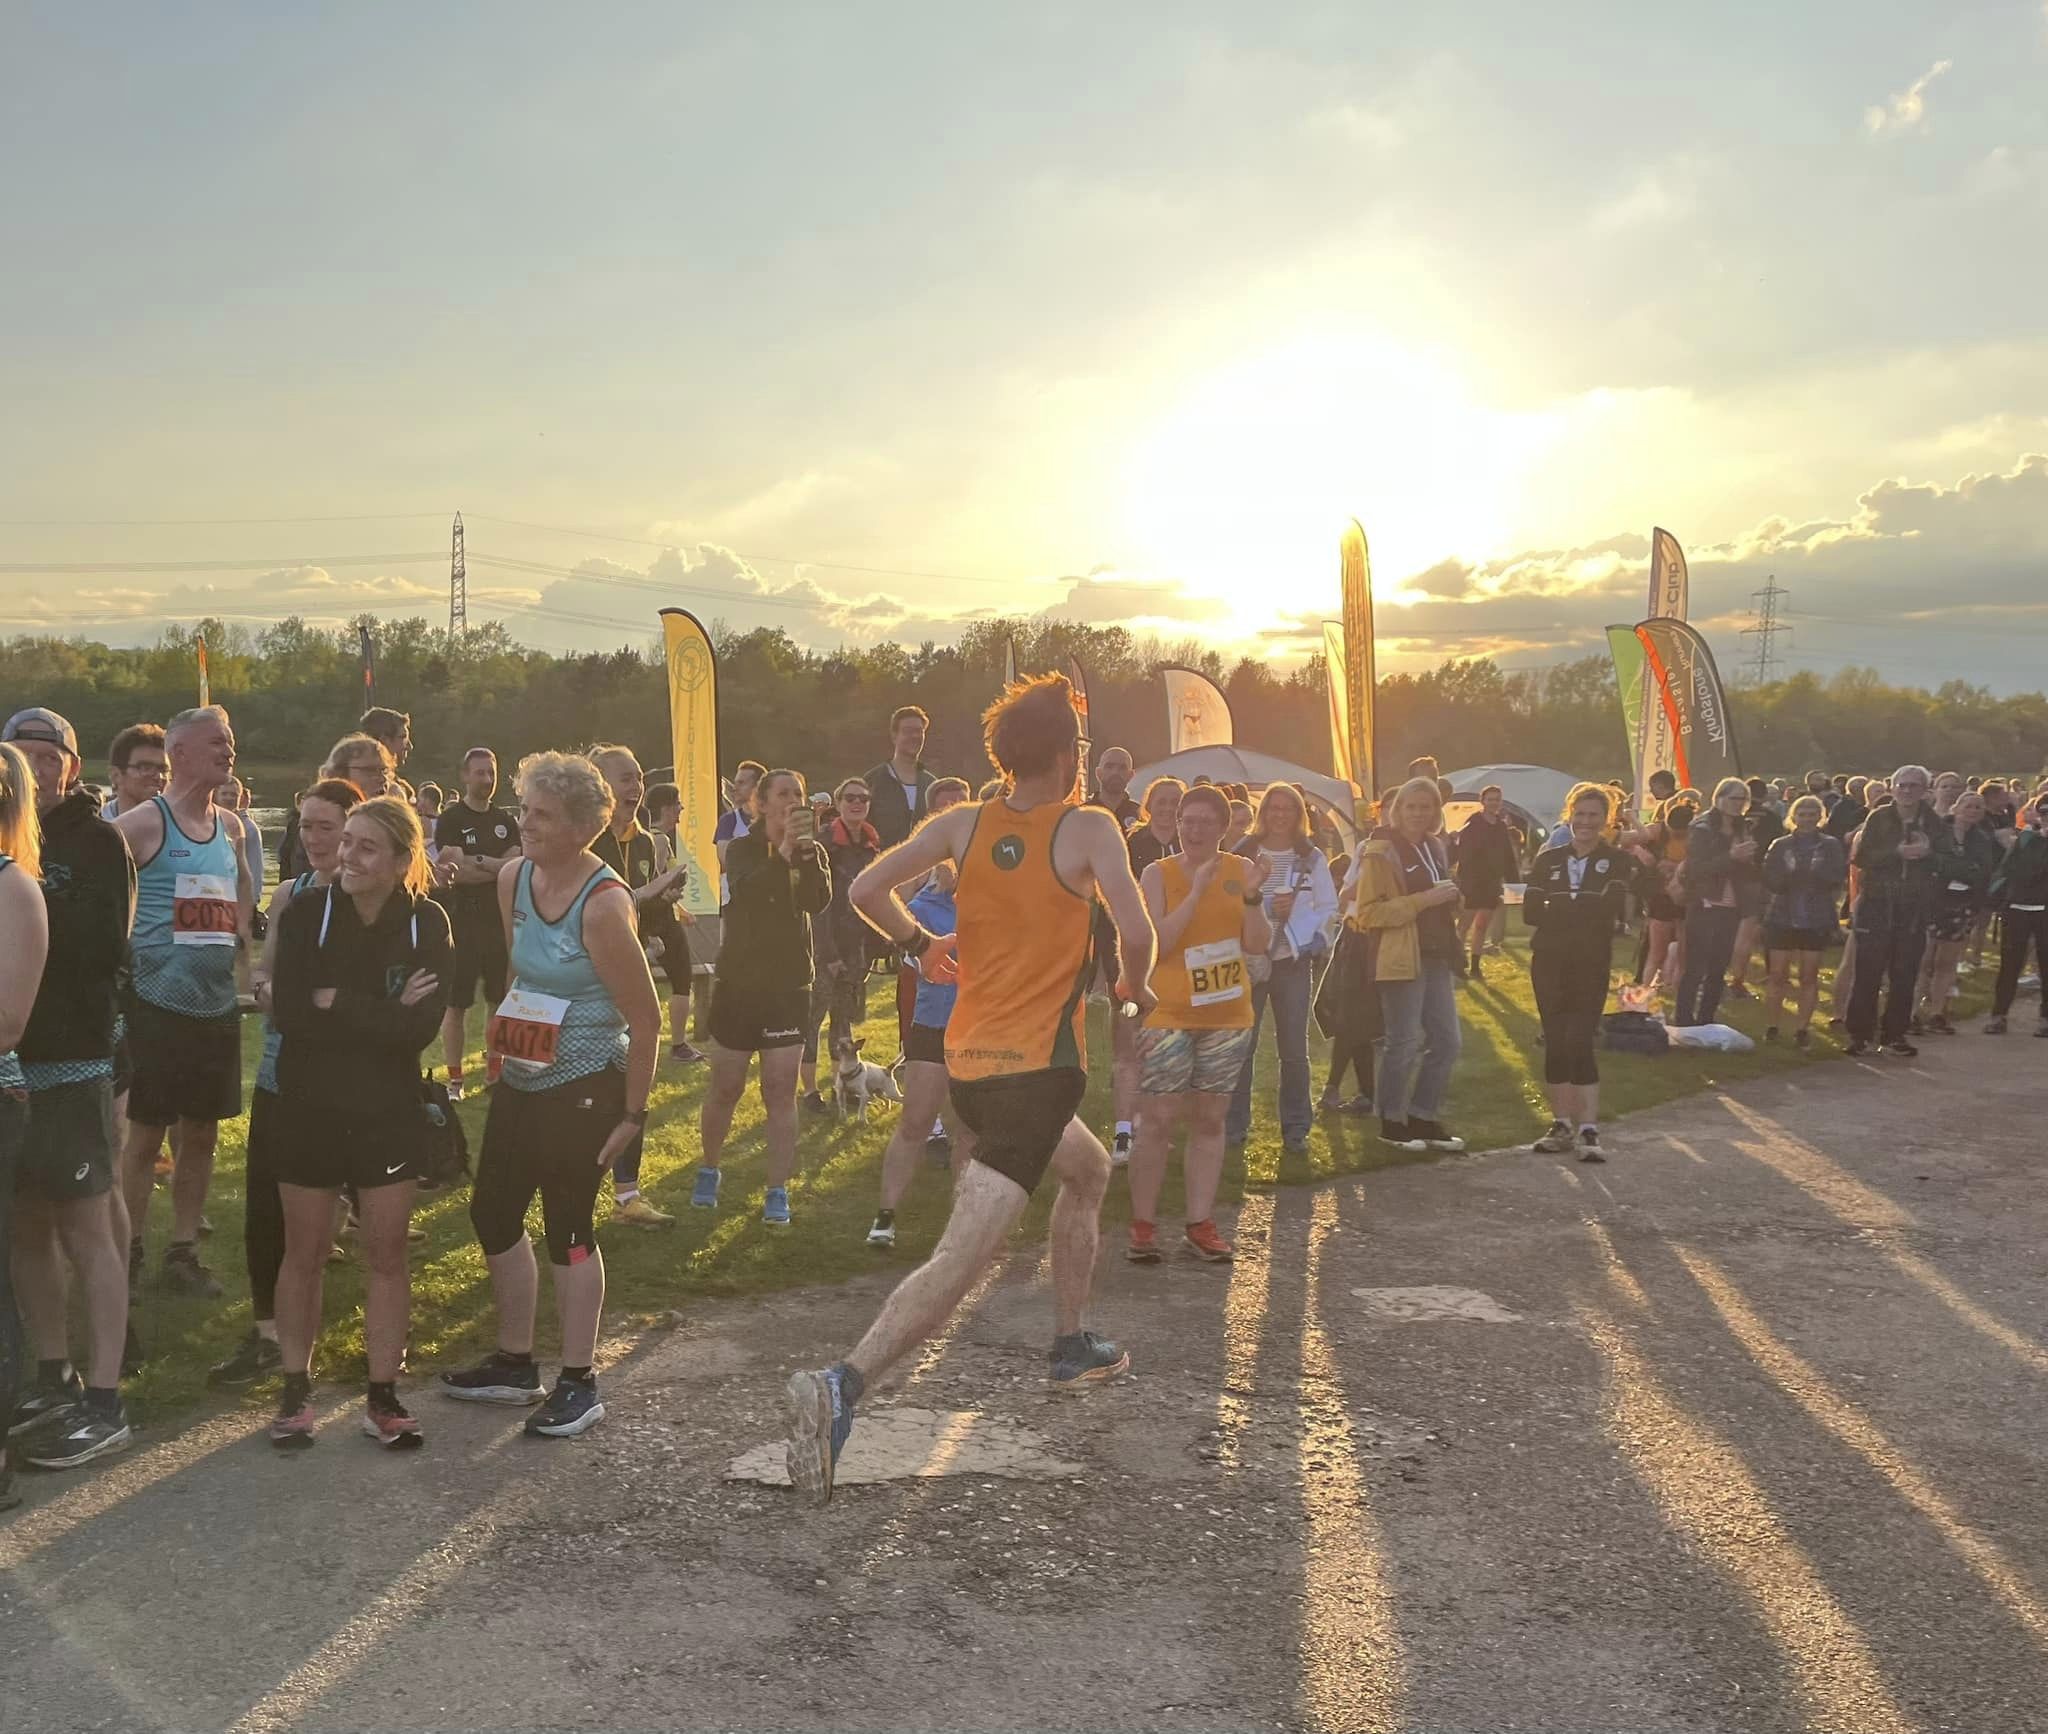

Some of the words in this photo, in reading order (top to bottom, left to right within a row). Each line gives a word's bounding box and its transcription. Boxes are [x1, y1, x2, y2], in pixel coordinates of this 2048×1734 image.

[465, 834, 476, 844] AH
[1192, 961, 1241, 993] B172
[494, 1020, 553, 1058] A074
